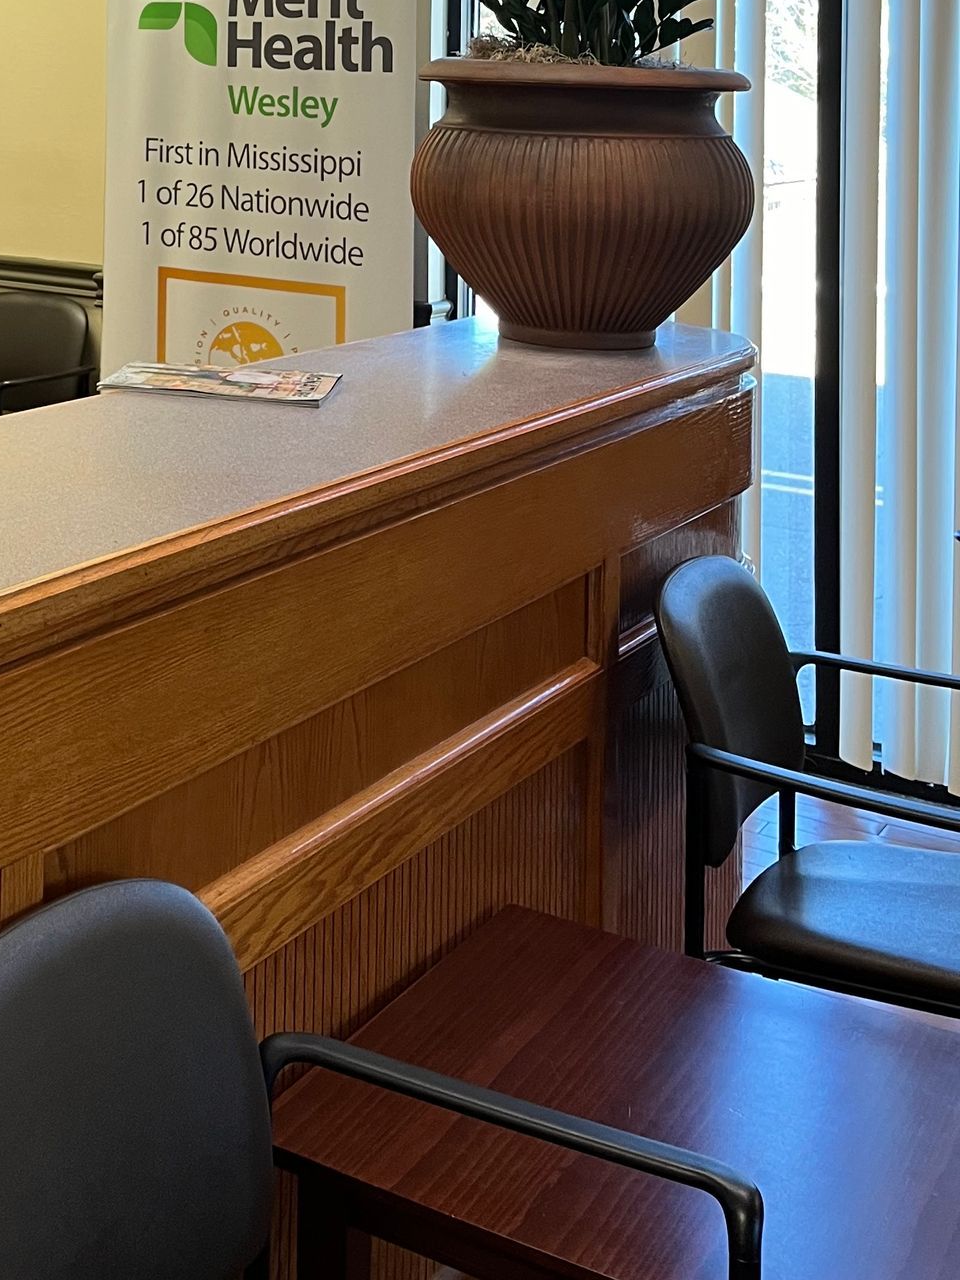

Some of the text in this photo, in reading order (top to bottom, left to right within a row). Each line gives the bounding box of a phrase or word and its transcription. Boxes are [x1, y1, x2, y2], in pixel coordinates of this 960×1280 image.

[227, 20, 393, 72] Health
[227, 84, 339, 129] Wesley
[145, 137, 362, 183] First in Mississippi
[136, 179, 370, 222] 1 of 26 Nationwide
[142, 221, 364, 267] 1 of 85 Worldwide
[222, 306, 281, 327] QUALITY
